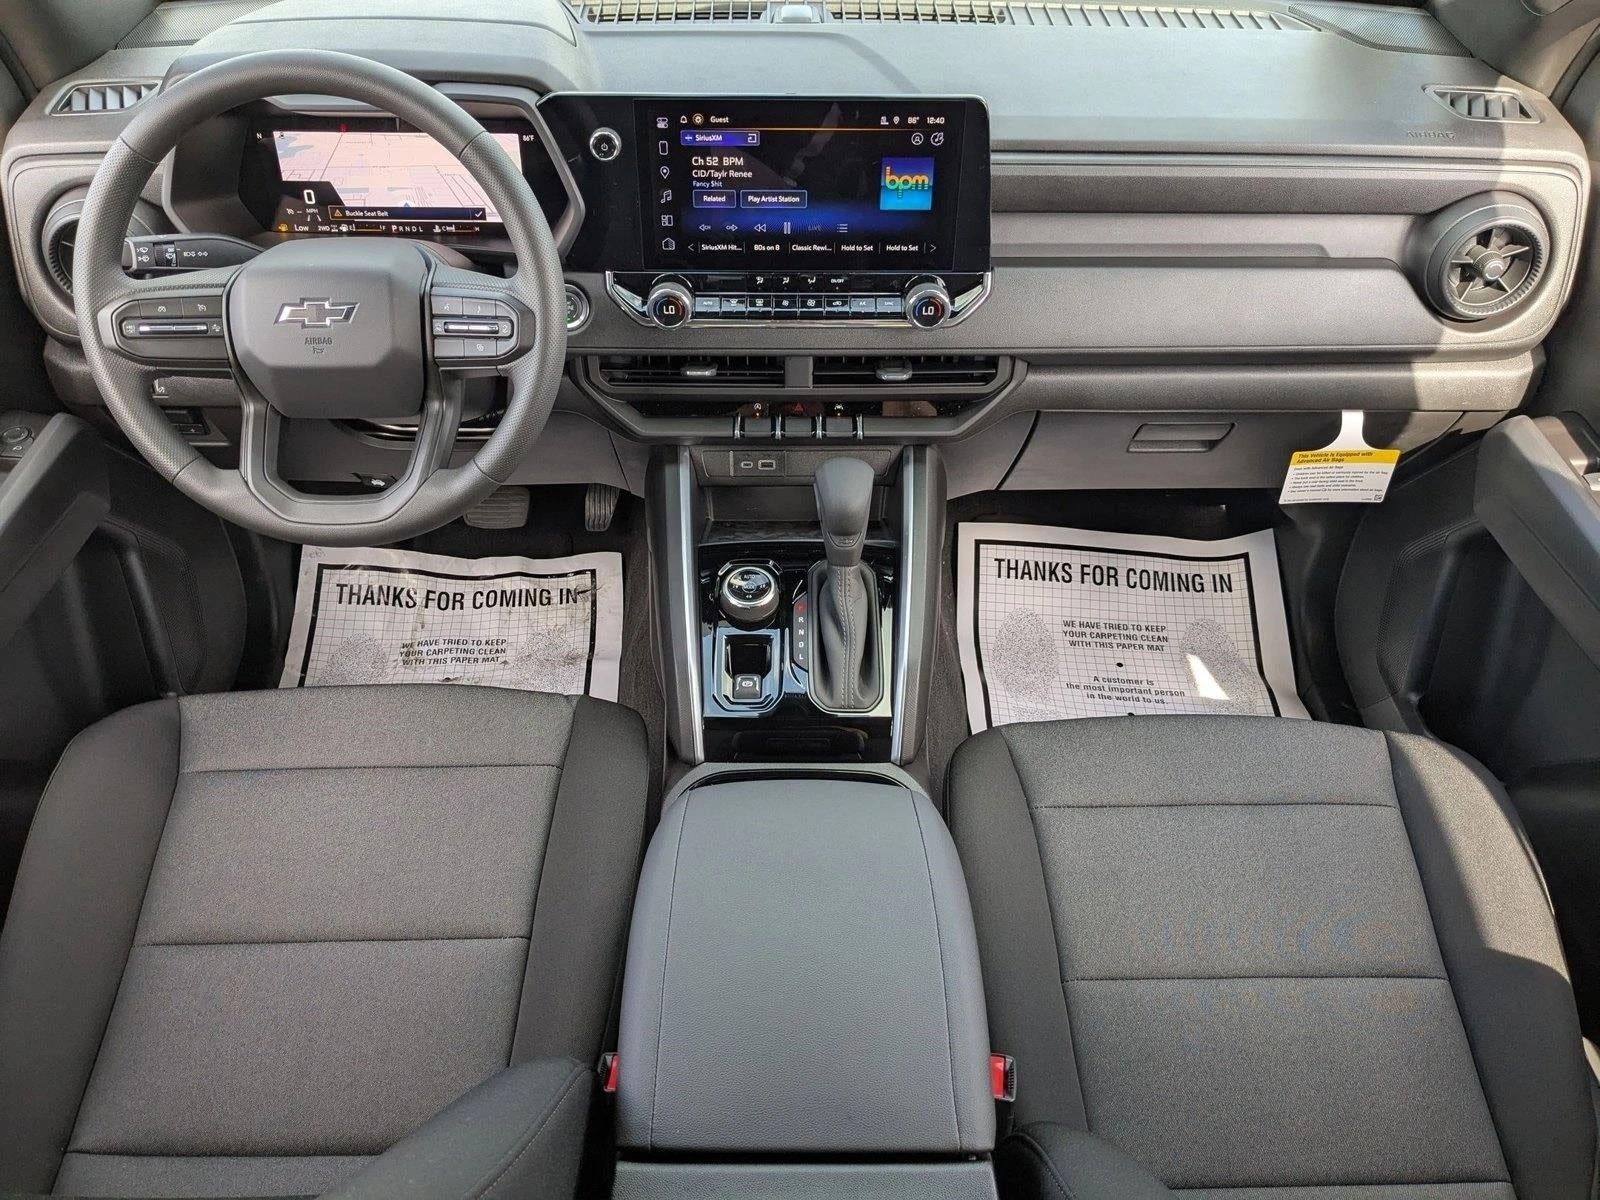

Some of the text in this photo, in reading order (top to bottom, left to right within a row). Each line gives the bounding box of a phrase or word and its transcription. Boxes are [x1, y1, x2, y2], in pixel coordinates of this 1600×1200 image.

[695, 134, 723, 142] SiriusXM
[691, 156, 744, 166] Ch 52 BPM
[692, 169, 753, 179] CID/Taylr Renee
[692, 181, 709, 189] Fancy
[885, 166, 929, 198] bpm
[303, 189, 316, 205] 0
[747, 195, 761, 203] Play
[391, 224, 398, 233] P
[663, 305, 675, 315] LO
[922, 306, 934, 316] LO
[305, 336, 333, 345] AIRBAG
[994, 558, 1233, 593] THANKS FOR COMING IN
[336, 583, 578, 611] THANKS FOR COMING IN
[1063, 620, 1167, 633] WE HAVE TRIED TO KEEP
[1062, 630, 1168, 643] YOUR CARPETING CLEAN
[417, 639, 440, 647] HAVE
[442, 638, 468, 646] TRIED
[485, 638, 507, 646] KEEP
[1069, 640, 1165, 652] WITH THIS PAPER MAT
[400, 649, 424, 658] YOUR
[426, 647, 475, 657] CARPETING
[402, 658, 425, 666] WITH
[450, 656, 479, 664] PAPER
[481, 656, 501, 664] MAT
[1102, 676, 1144, 686] customer
[1066, 682, 1185, 698] the most important person
[1115, 694, 1140, 703] world
[1154, 697, 1169, 705] us.
